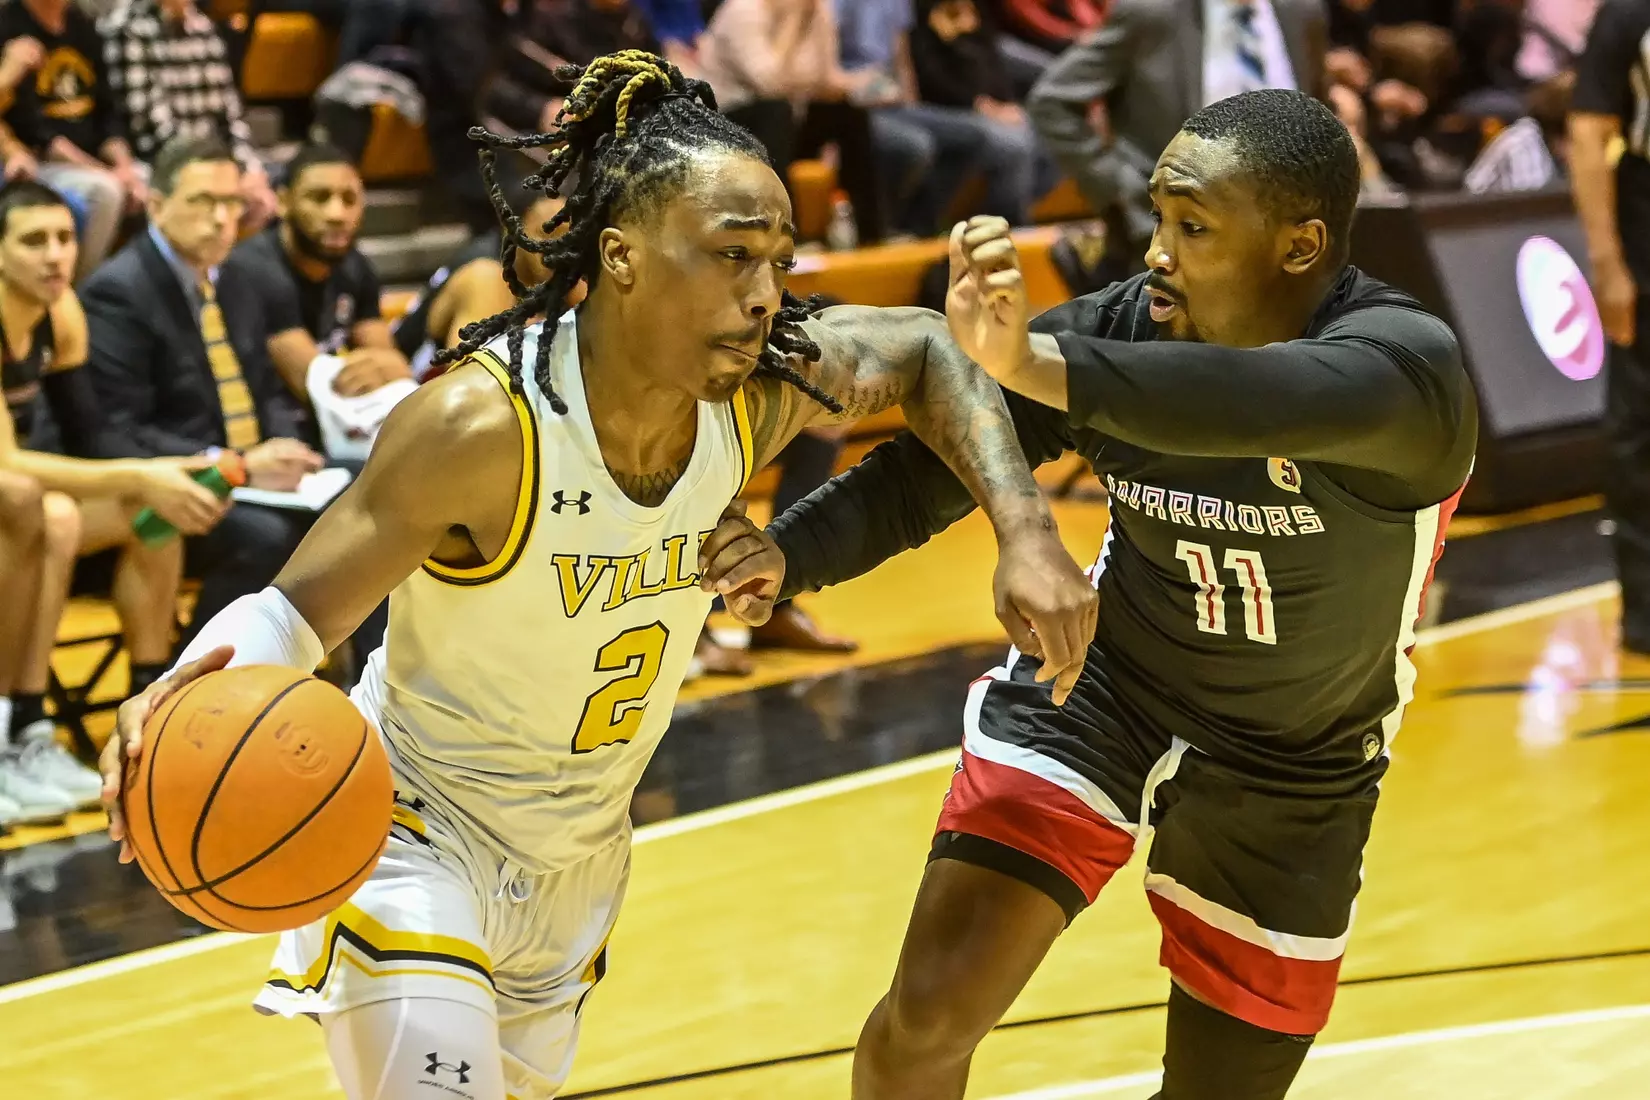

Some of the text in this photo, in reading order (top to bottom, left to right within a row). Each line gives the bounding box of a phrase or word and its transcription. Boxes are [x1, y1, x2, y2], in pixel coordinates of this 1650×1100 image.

[1106, 473, 1326, 537] WARRIORS
[550, 527, 717, 619] VILL
[1175, 539, 1277, 645] 11
[571, 619, 670, 754] 2
